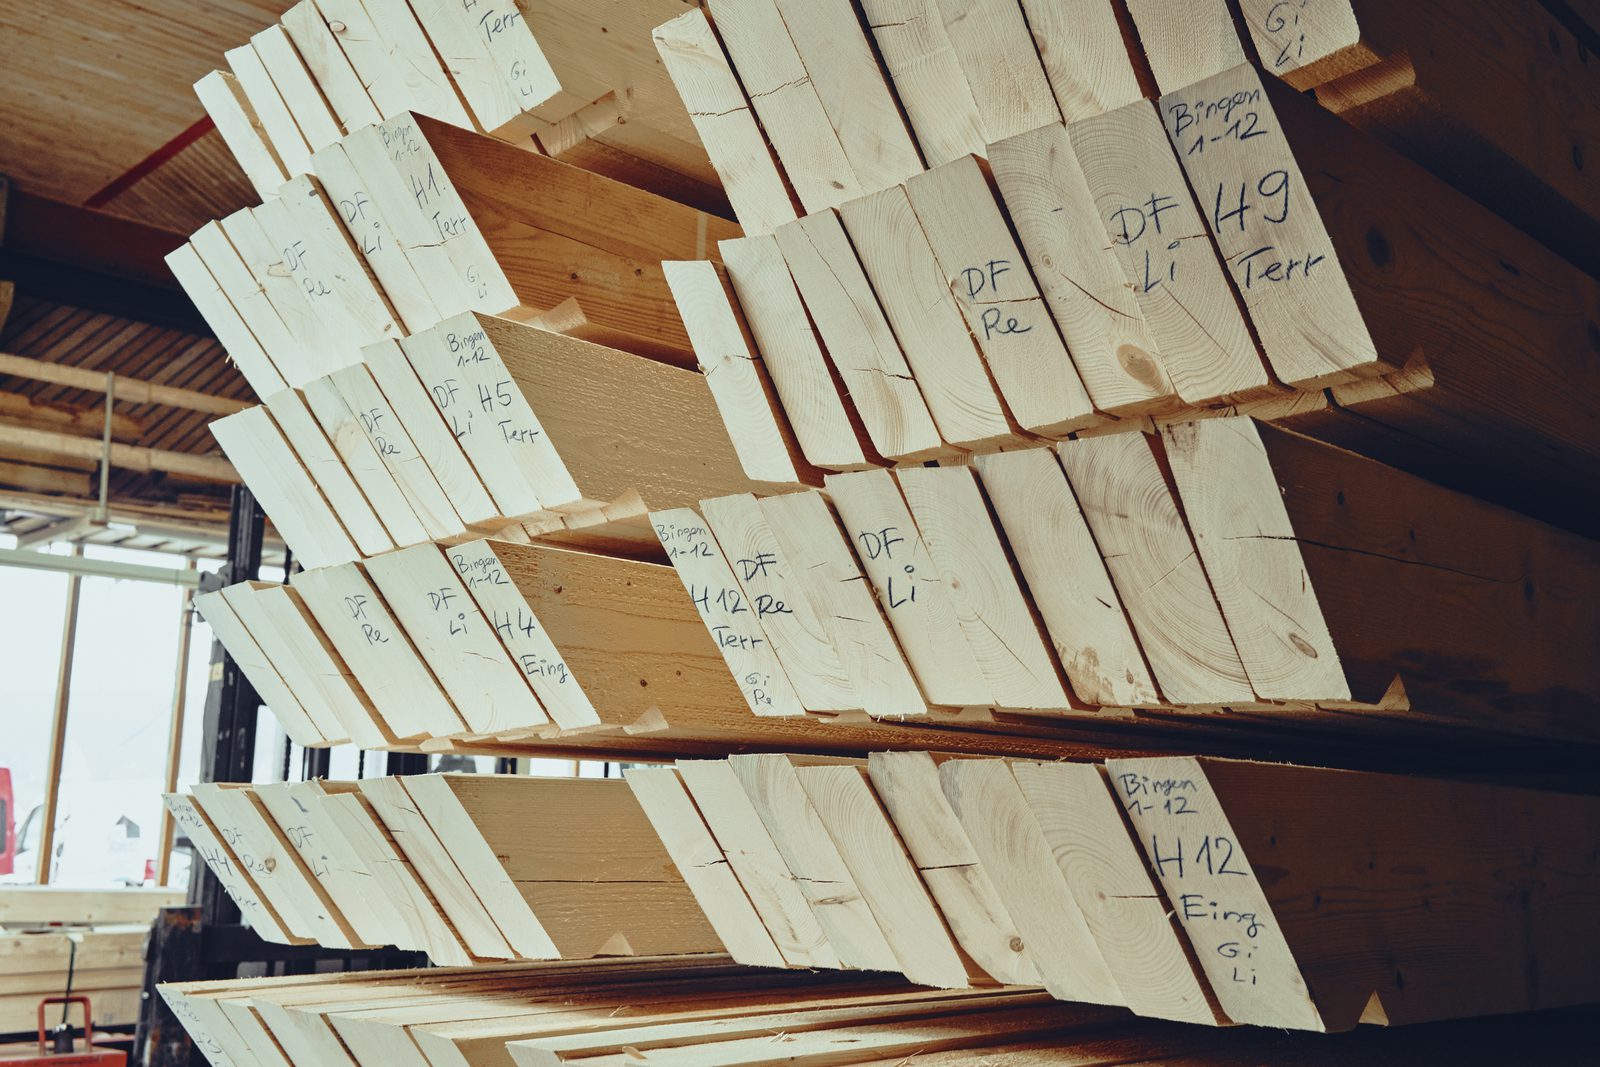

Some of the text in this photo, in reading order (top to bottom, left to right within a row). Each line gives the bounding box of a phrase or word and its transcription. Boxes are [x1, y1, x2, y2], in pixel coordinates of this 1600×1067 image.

[479, 9, 520, 42] Terr
[1168, 87, 1261, 137] Bingen
[1187, 111, 1267, 156] 1-12
[340, 191, 369, 225] DF
[1213, 169, 1290, 235] H9
[432, 211, 467, 240] Terr
[1110, 192, 1180, 246] DF
[362, 221, 383, 255] Li
[284, 240, 307, 272] DF
[1142, 240, 1182, 294] Li
[1236, 246, 1326, 290] Terr
[303, 277, 331, 301] Re
[961, 259, 1012, 299] DF
[980, 307, 1033, 342] Re
[457, 346, 491, 368] 1-12
[433, 379, 460, 409] DF
[360, 407, 384, 434] DF
[452, 410, 473, 439] Li
[497, 420, 539, 444] Terr
[375, 437, 401, 458] Re
[656, 523, 707, 544] Bingen
[858, 527, 905, 560] DF
[669, 541, 714, 559] 1-12
[468, 569, 510, 589] 1-12
[736, 552, 777, 581] DF
[427, 587, 457, 611] DF
[887, 564, 916, 609] Li
[344, 594, 368, 620] DF
[754, 594, 793, 620] Re
[361, 623, 389, 645] Re
[449, 612, 468, 636] Li
[712, 625, 763, 650] Terr
[520, 653, 568, 683] Eing
[1119, 773, 1198, 799] Bingen
[1127, 796, 1198, 816] 1-12
[286, 825, 314, 849] DF
[311, 855, 330, 878] Li
[1179, 894, 1266, 938] Eing
[1233, 967, 1257, 985] Li
